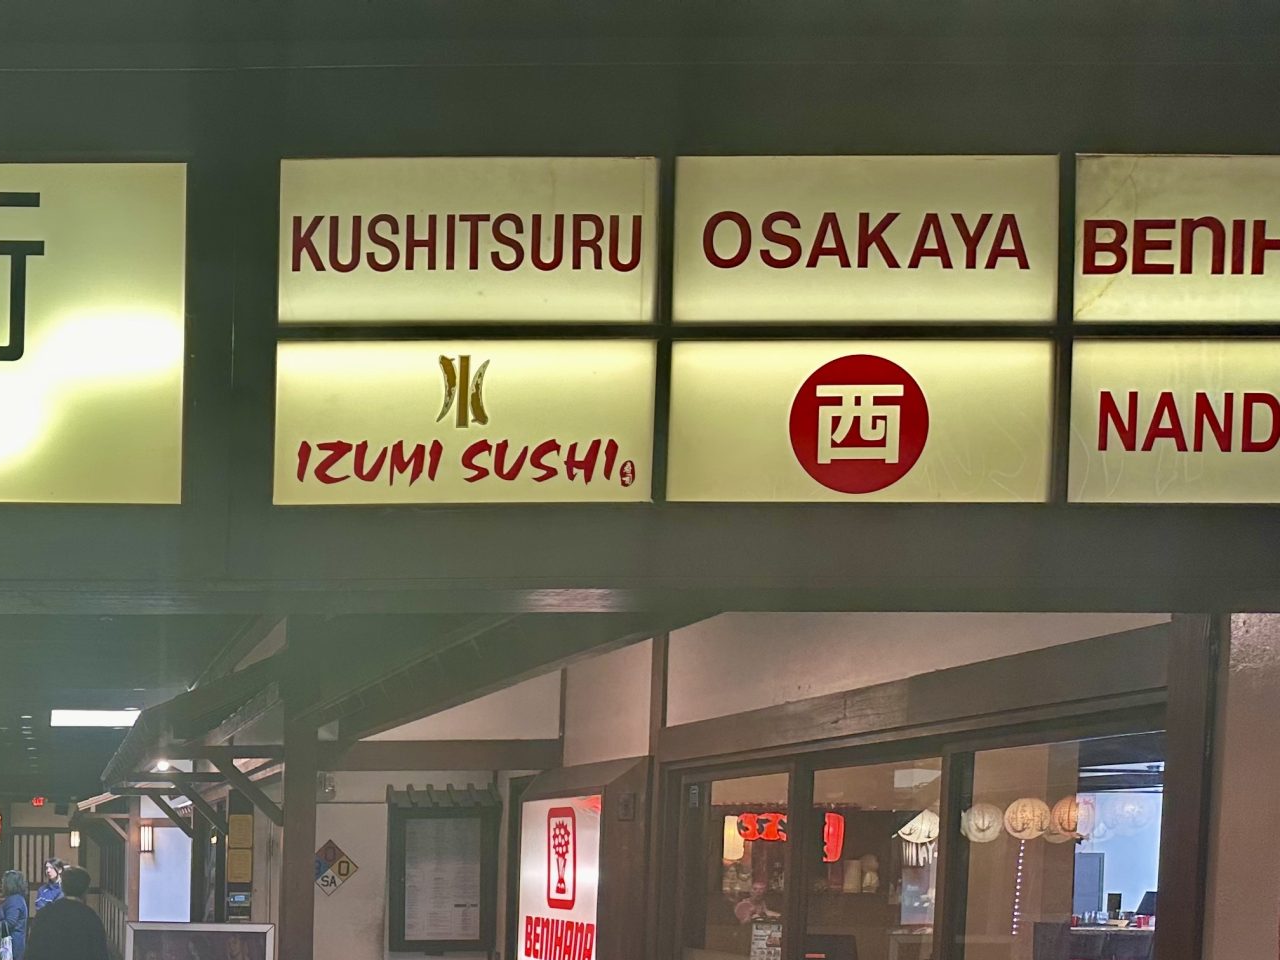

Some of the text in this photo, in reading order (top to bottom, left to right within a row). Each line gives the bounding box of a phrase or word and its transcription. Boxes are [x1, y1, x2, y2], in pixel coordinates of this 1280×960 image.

[291, 213, 642, 272] KUSHITSURU
[703, 210, 1030, 270] OSAKAYA
[816, 384, 904, 464] 西
[1097, 391, 1280, 453] NAND
[296, 440, 444, 487] IZUMI
[461, 438, 620, 485] SUSHI
[321, 875, 337, 887] SA
